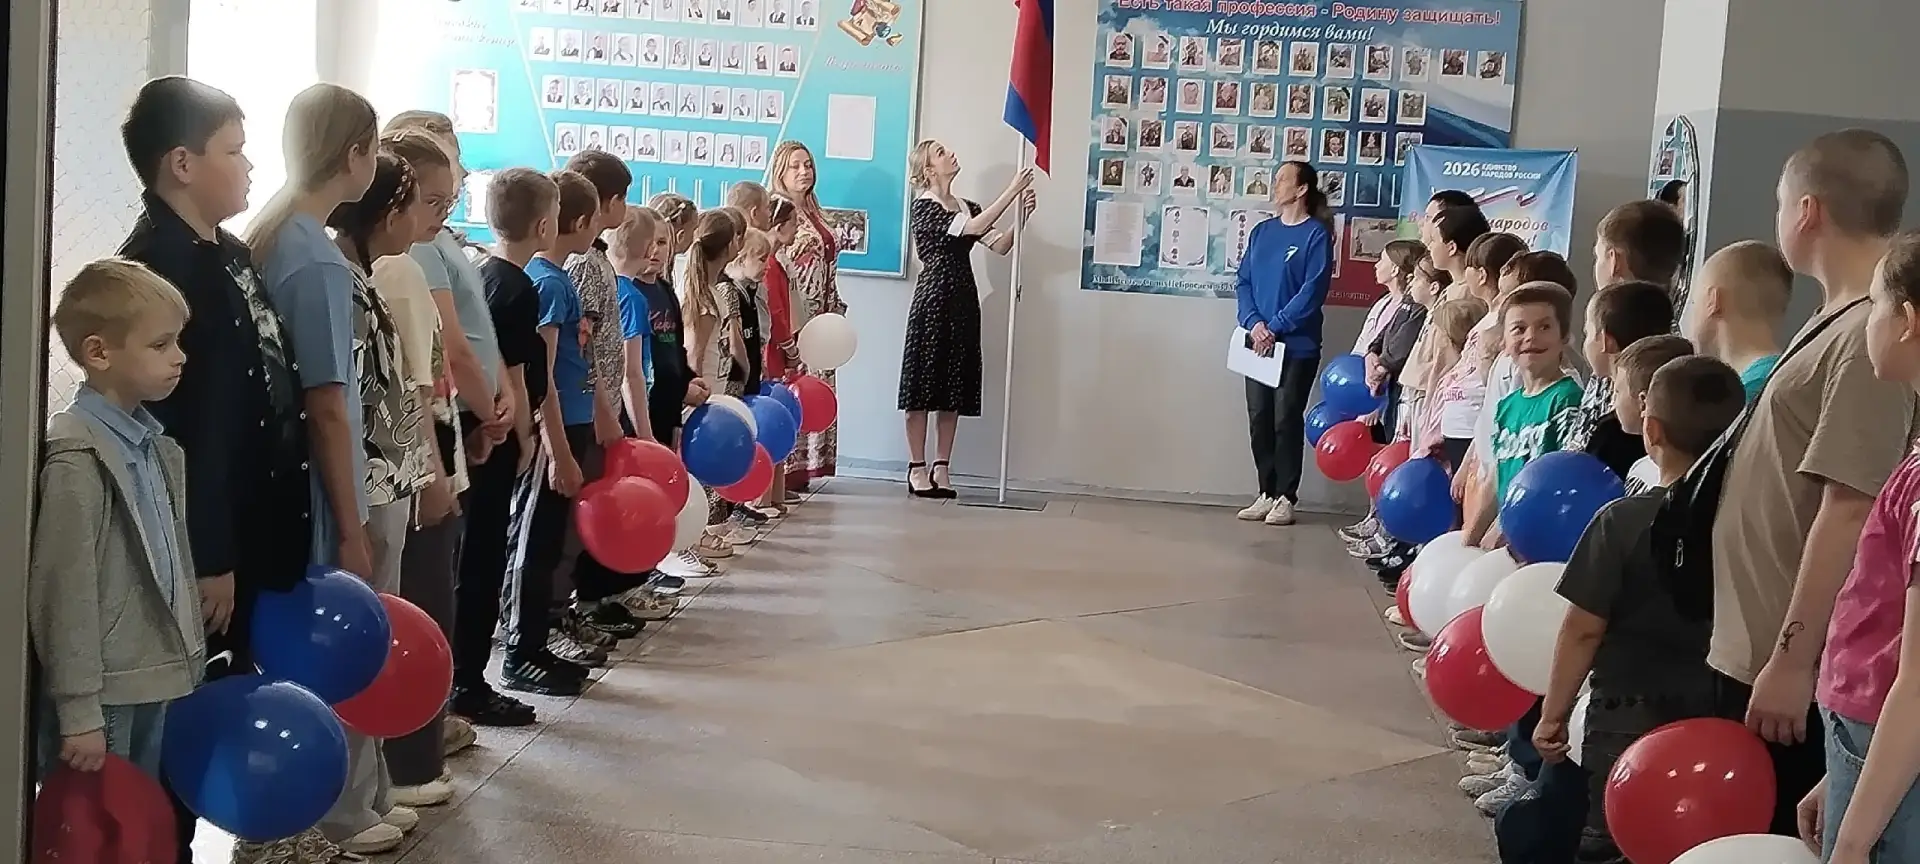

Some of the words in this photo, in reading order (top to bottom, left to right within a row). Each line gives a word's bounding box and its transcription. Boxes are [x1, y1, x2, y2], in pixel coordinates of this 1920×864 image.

[1165, 0, 1213, 12] такая
[1217, 1, 1316, 18] профессия
[1332, 2, 1399, 24] Родину
[1403, 8, 1501, 26] защищать!
[1205, 19, 1237, 34] Мы
[1241, 21, 1321, 39] гордимся
[1324, 25, 1375, 42] вами!
[1443, 161, 1480, 177] 2026
[1481, 163, 1518, 171] ЕДИНСТВО
[1481, 171, 1513, 179] НАРОДОВ
[1514, 172, 1542, 180] РОССИИ
